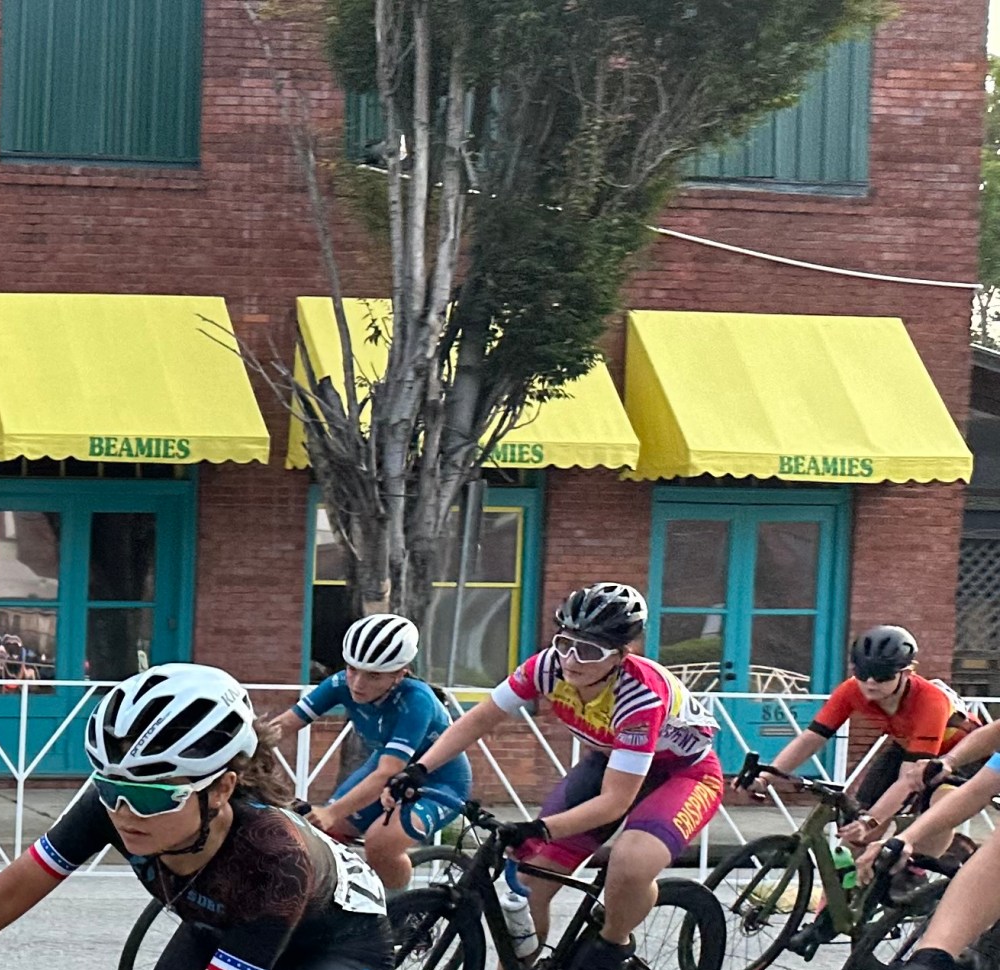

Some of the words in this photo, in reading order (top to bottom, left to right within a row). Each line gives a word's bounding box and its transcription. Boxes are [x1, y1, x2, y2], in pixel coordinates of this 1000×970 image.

[89, 436, 191, 459] BEAMIES
[490, 443, 544, 464] MIES
[778, 455, 874, 478] BEAMIES
